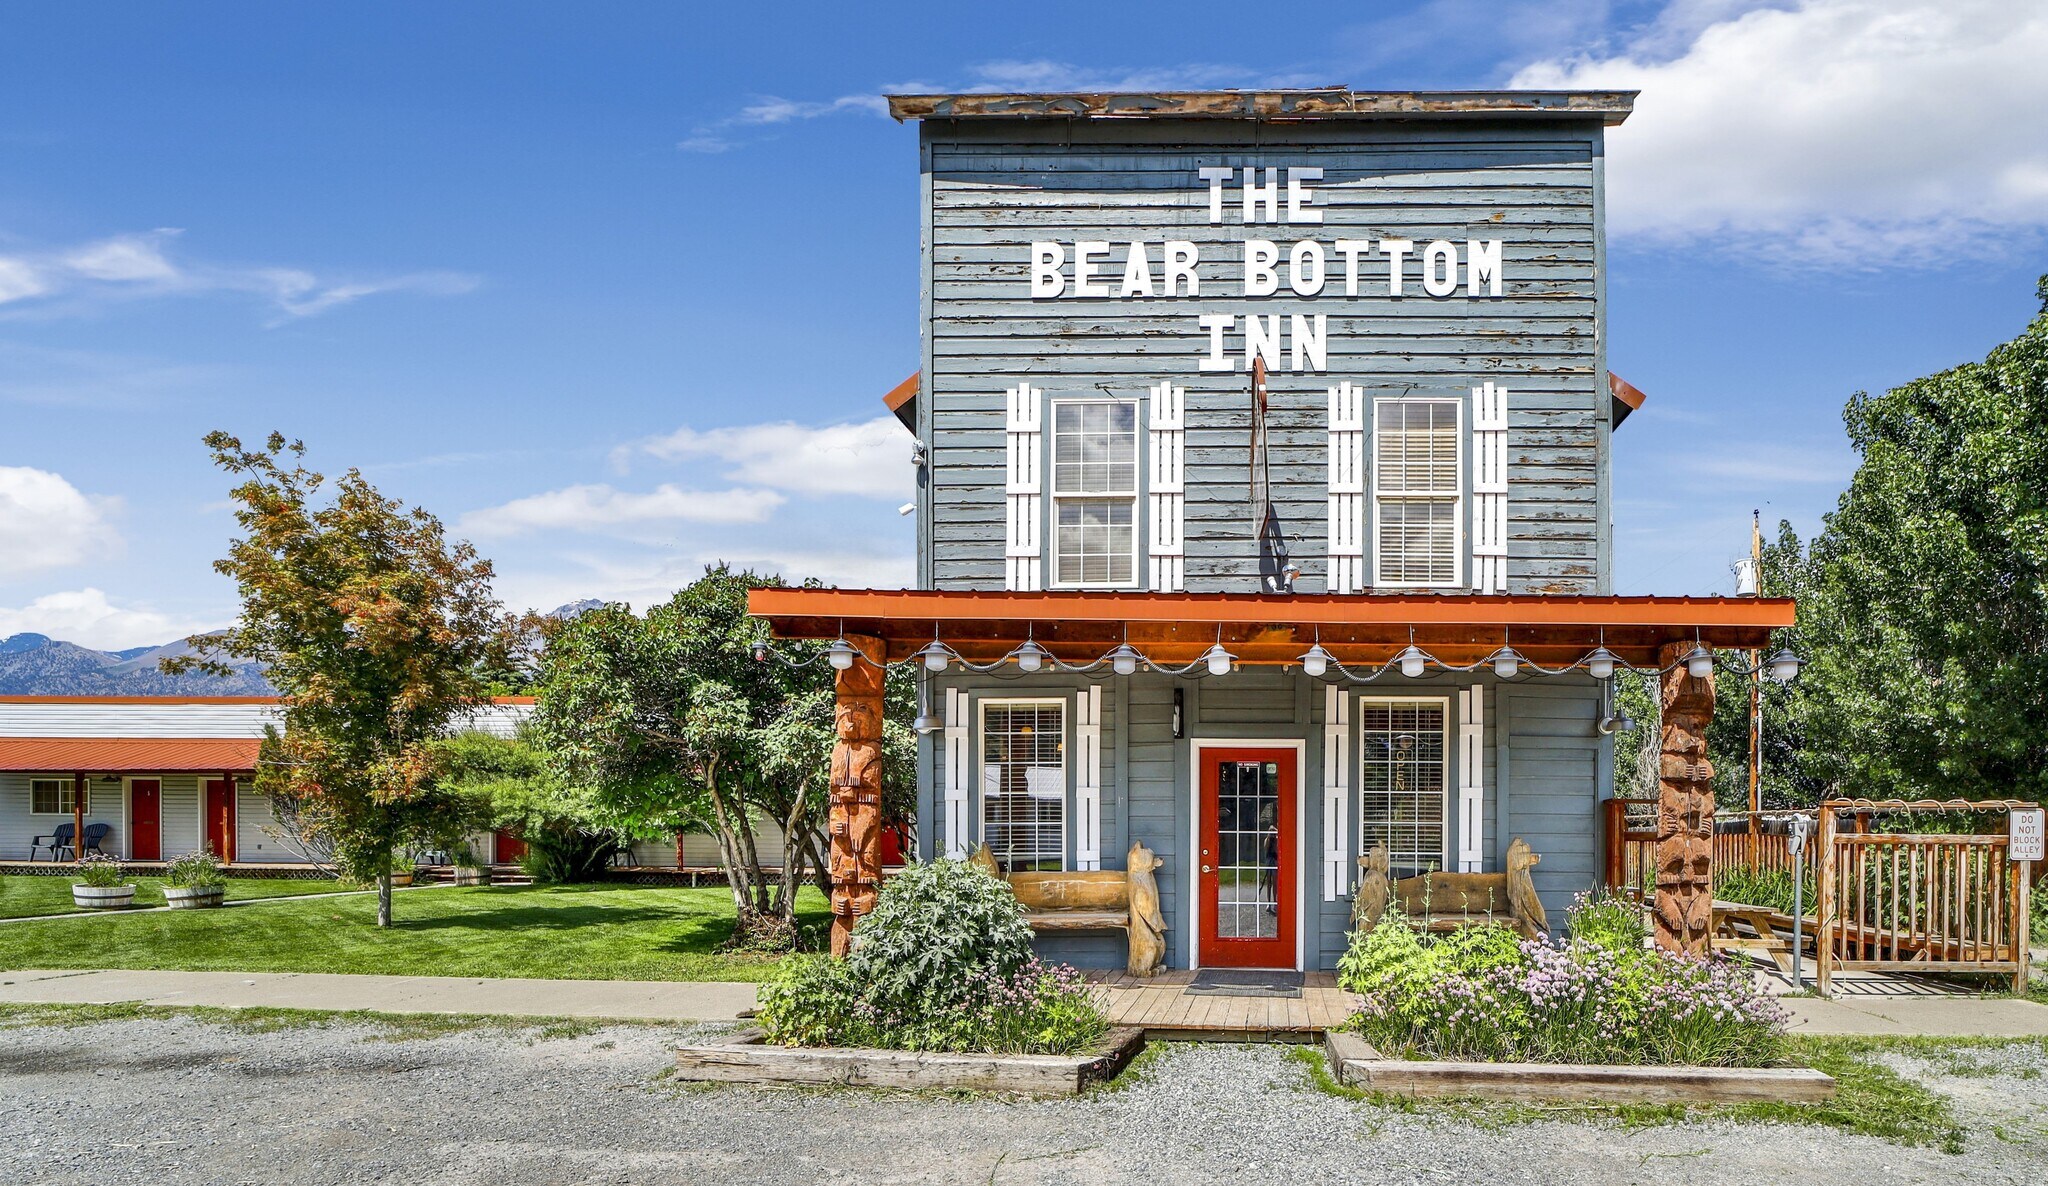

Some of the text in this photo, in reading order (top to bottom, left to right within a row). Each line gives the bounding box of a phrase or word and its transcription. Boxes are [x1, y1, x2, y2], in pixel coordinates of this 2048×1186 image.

[1199, 167, 1323, 224] THE
[1031, 239, 1502, 298] BEAR BOTTOM
[1199, 314, 1327, 372] INN
[1396, 751, 1405, 790] OPEN
[2018, 826, 2036, 834] NOT
[2021, 815, 2033, 823] DO
[2014, 836, 2040, 844] BLOCK
